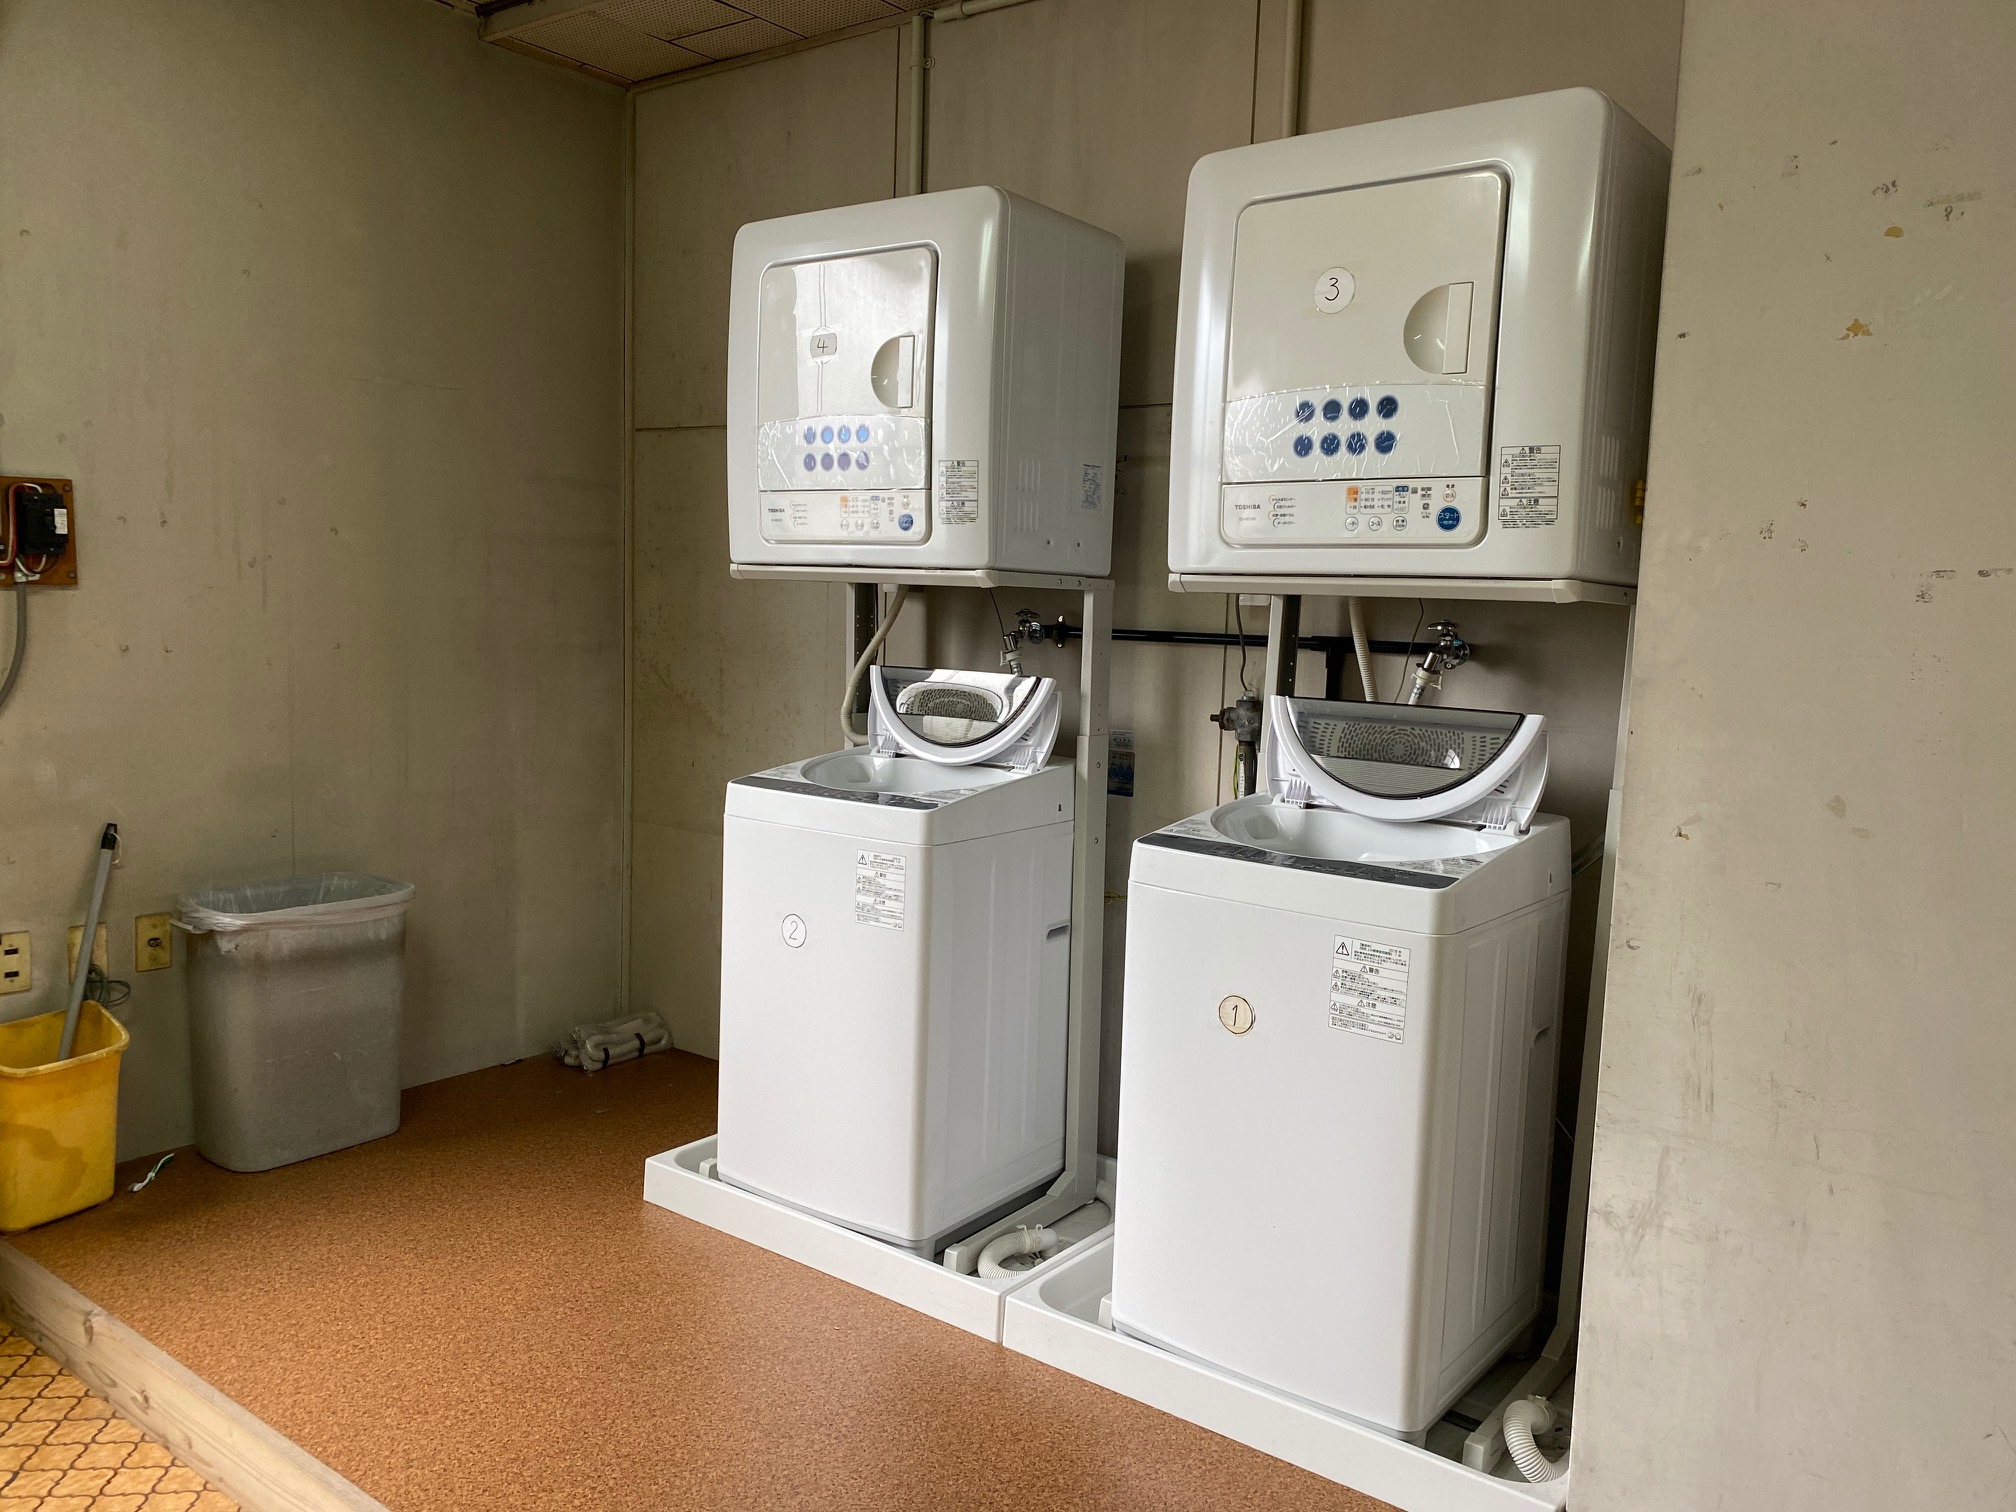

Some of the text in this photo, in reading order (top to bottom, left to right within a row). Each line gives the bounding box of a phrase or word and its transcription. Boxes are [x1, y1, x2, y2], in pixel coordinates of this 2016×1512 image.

[1325, 277, 1340, 302] 3
[816, 338, 829, 354] 4
[789, 920, 798, 940] 2
[1232, 1004, 1238, 1026] 1
